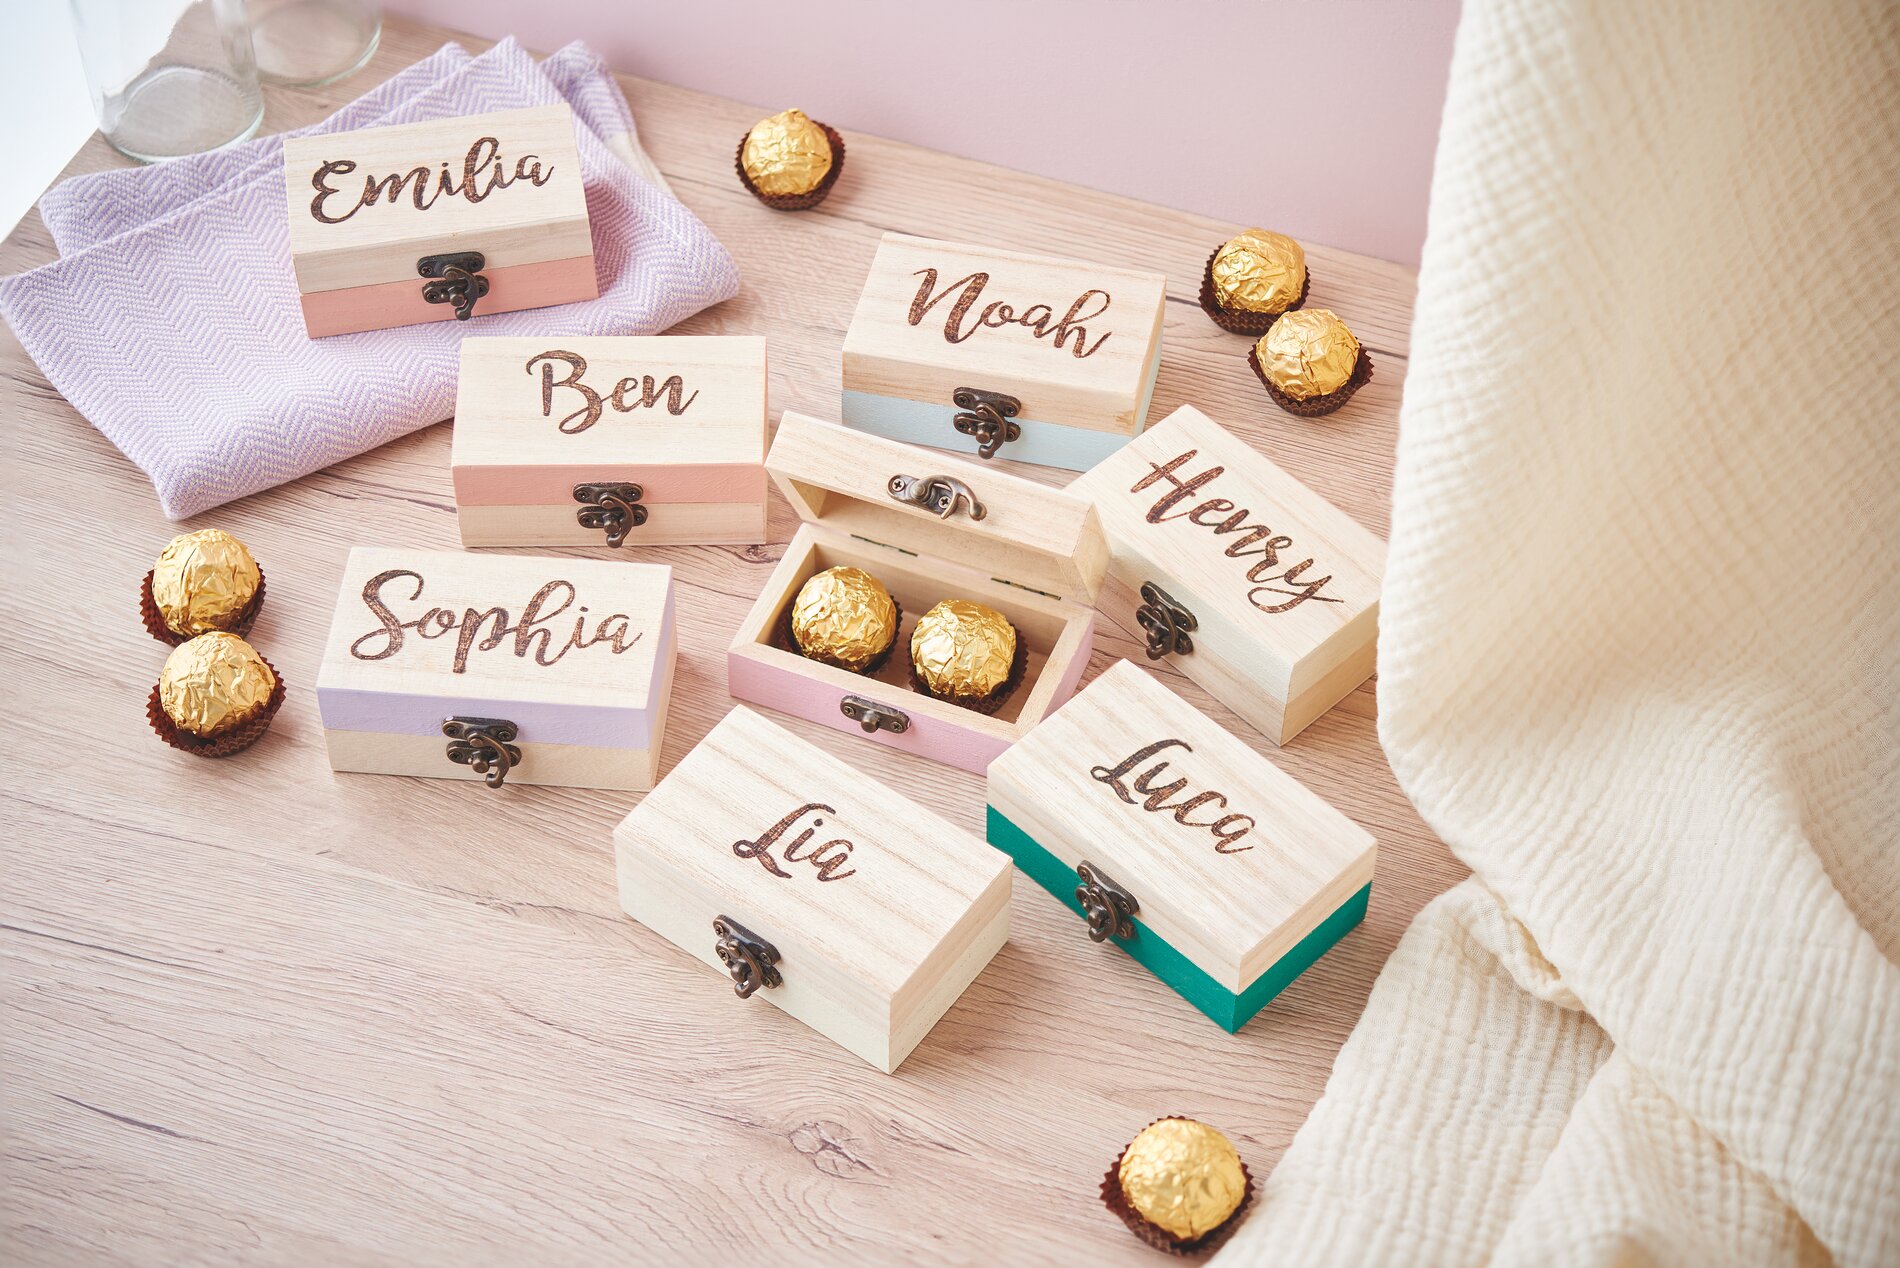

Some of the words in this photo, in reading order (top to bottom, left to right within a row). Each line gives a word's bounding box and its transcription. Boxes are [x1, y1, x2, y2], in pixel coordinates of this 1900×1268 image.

[310, 136, 555, 225] Emilia
[908, 267, 1112, 359] Noah
[526, 350, 700, 435] Ben
[1130, 448, 1345, 614] Henry
[351, 570, 644, 674] Sophia
[733, 803, 857, 882] Lia
[1090, 738, 1256, 855] Luca
